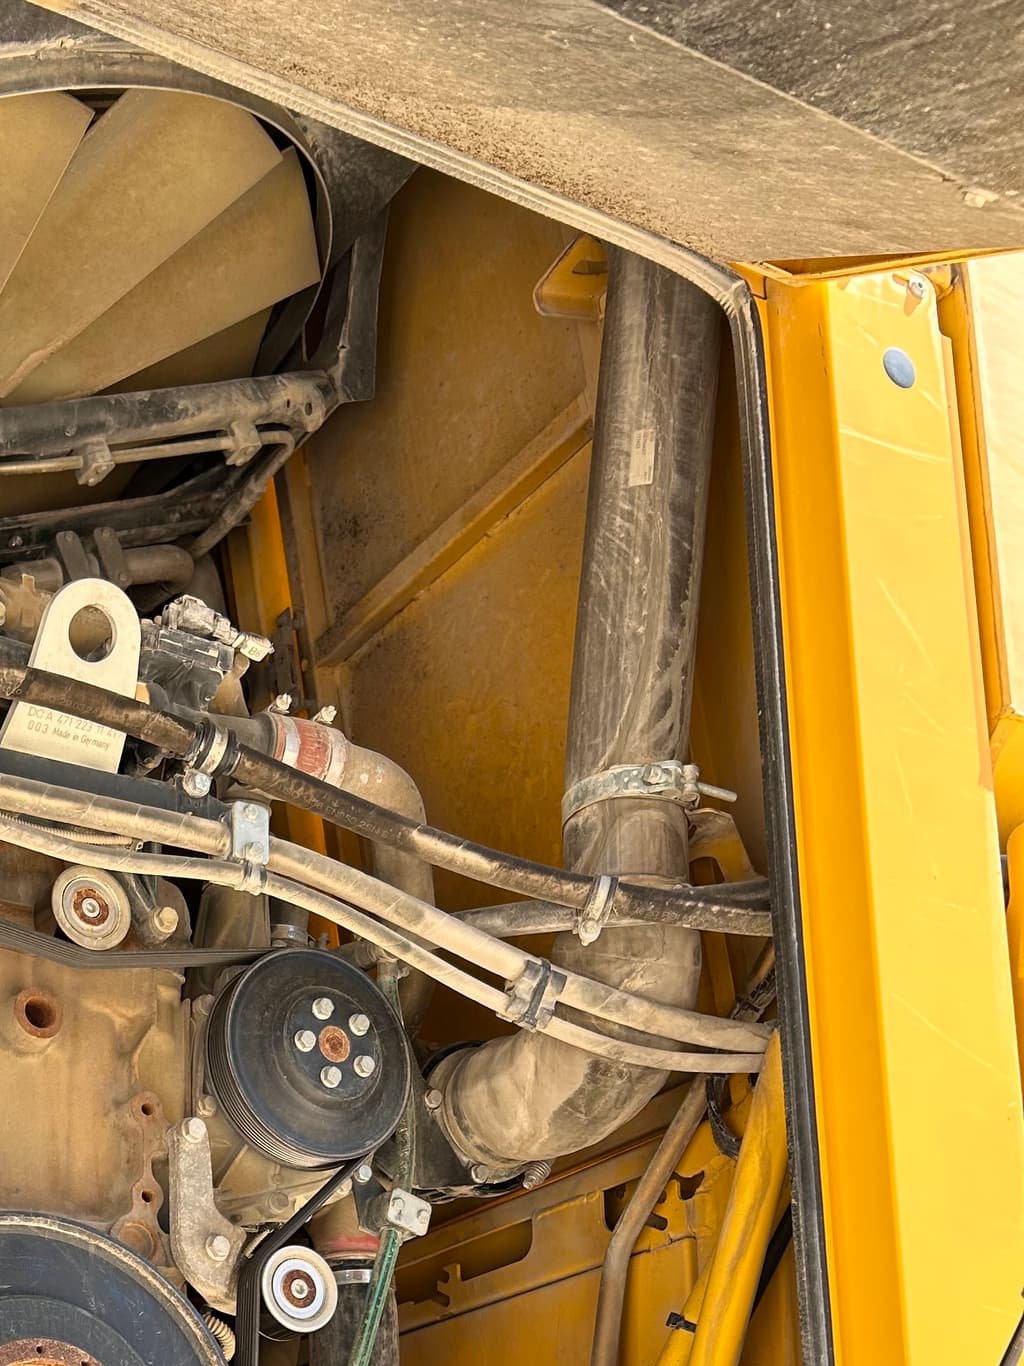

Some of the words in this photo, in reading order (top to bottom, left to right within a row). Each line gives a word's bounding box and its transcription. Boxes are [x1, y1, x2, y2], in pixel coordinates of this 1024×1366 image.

[27, 720, 49, 734] 003
[52, 727, 71, 738] Made
[80, 734, 110, 751] Germany
